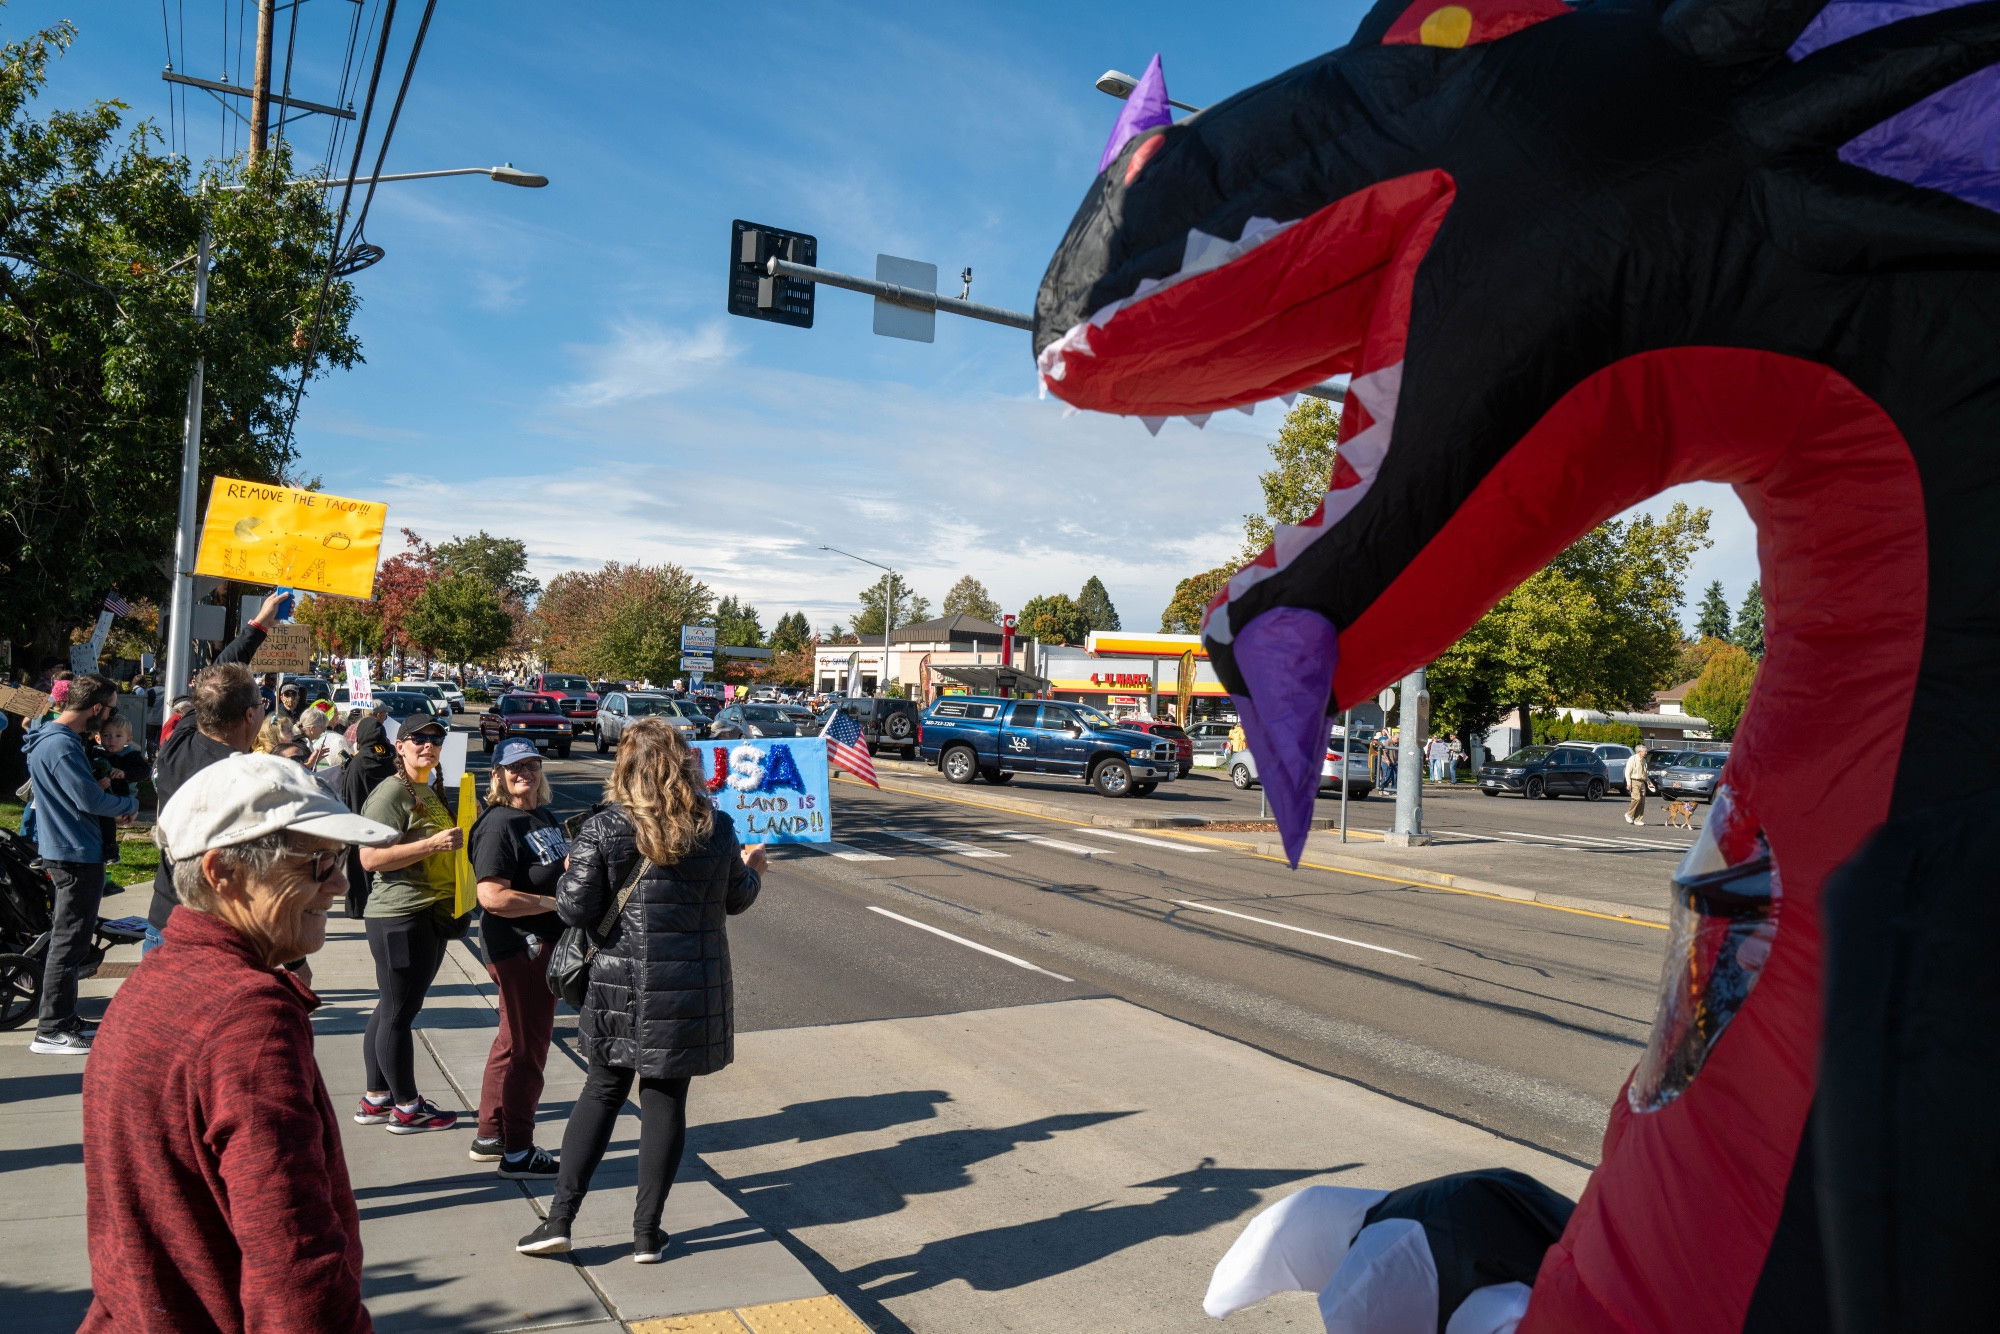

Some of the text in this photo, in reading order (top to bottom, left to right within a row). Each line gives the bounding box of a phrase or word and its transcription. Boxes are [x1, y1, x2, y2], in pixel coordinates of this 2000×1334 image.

[227, 483, 284, 503] REMOVE
[292, 493, 315, 507] THE
[272, 626, 288, 634] THE
[266, 635, 309, 644] STITUTION
[271, 643, 288, 651] NOT
[260, 650, 297, 658] FUCKING
[251, 659, 304, 667] SUGGESTION
[1090, 673, 1148, 685] 4 U MART
[689, 744, 807, 794] USA
[736, 793, 789, 812] LAND
[798, 794, 816, 810] IS
[747, 811, 824, 836] LAND!!
